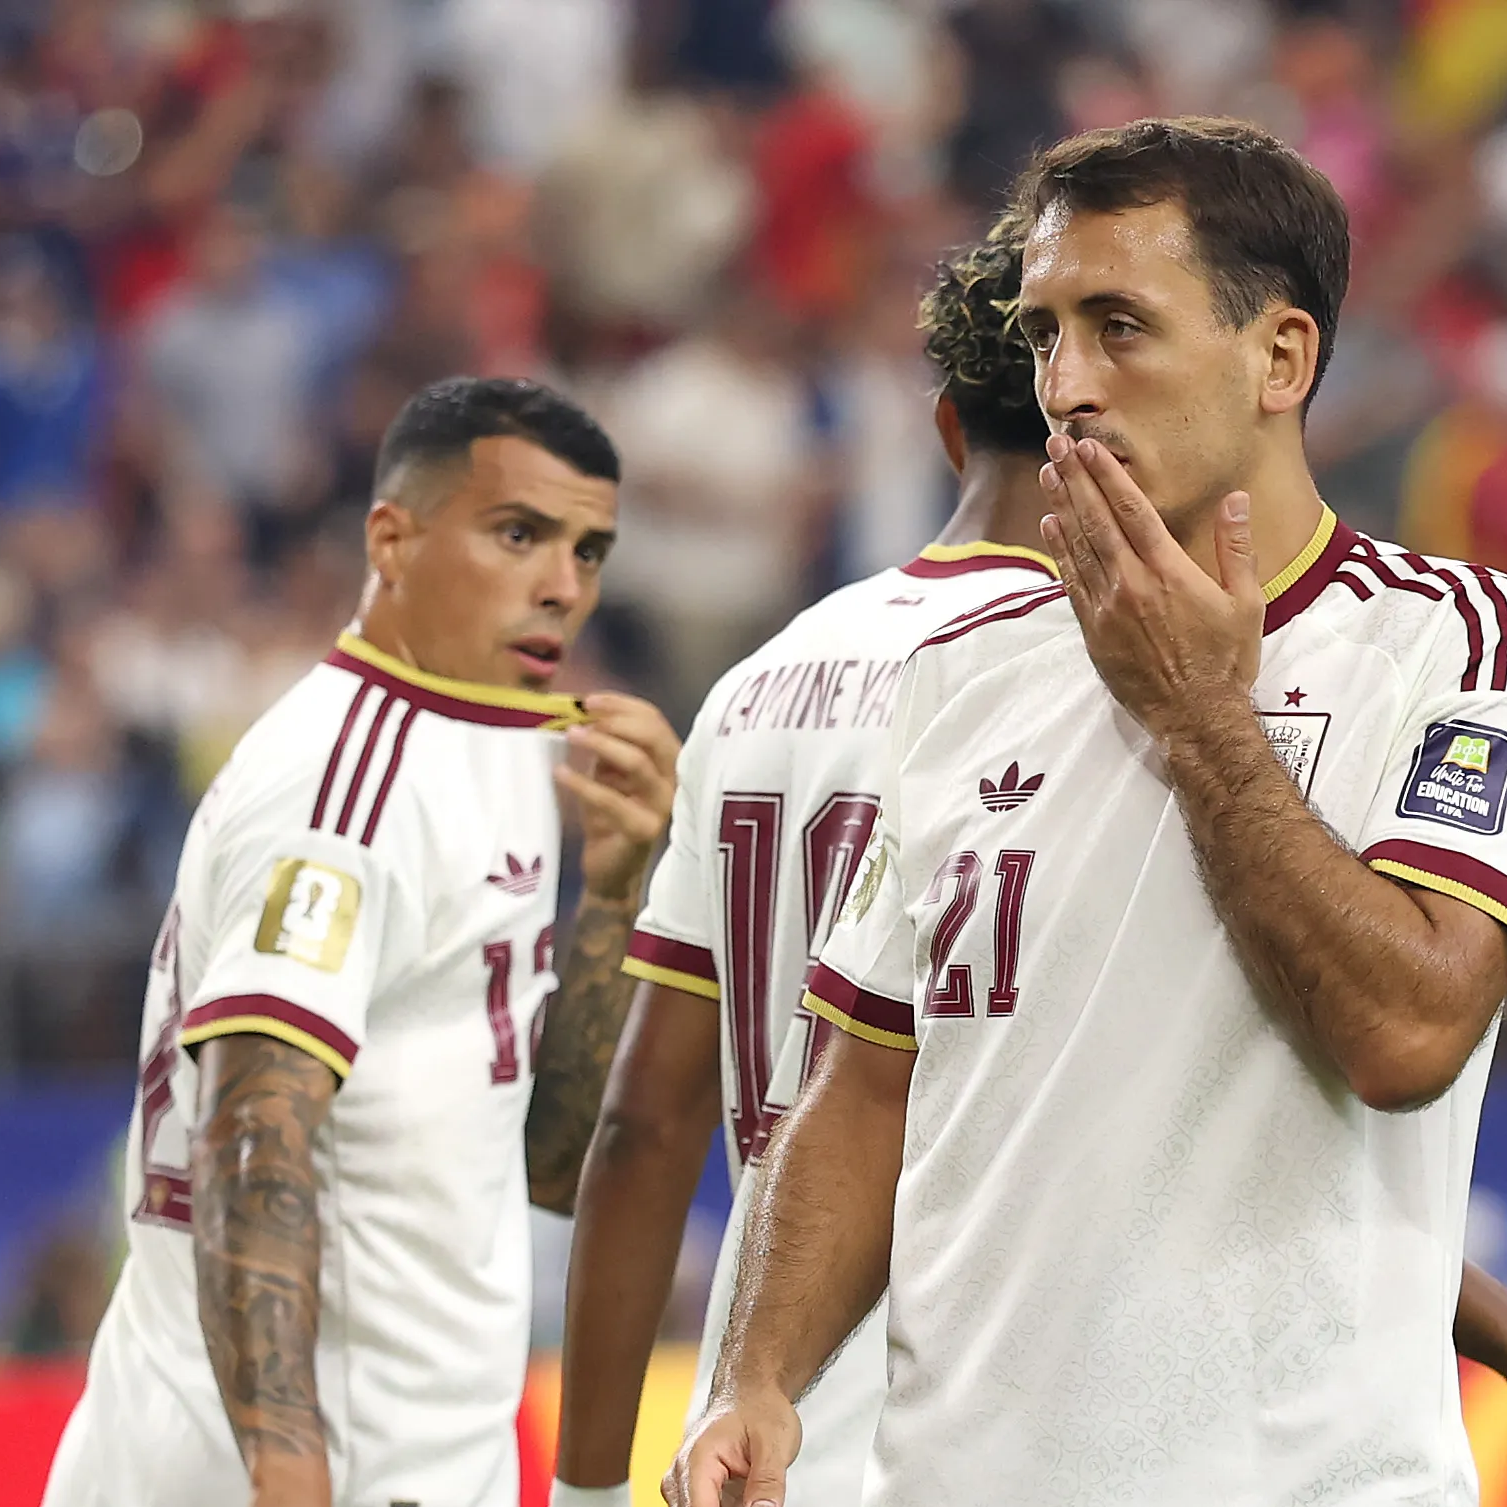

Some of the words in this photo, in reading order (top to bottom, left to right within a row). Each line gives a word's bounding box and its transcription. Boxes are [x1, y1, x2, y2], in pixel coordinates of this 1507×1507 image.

[717, 659, 860, 737] LAMINE
[850, 659, 903, 729] YA
[1430, 764, 1465, 787] Unite
[1465, 774, 1486, 793] For
[1416, 781, 1490, 817] EDUCATION
[1435, 802, 1465, 819] FIFA
[921, 849, 1036, 1018] 21
